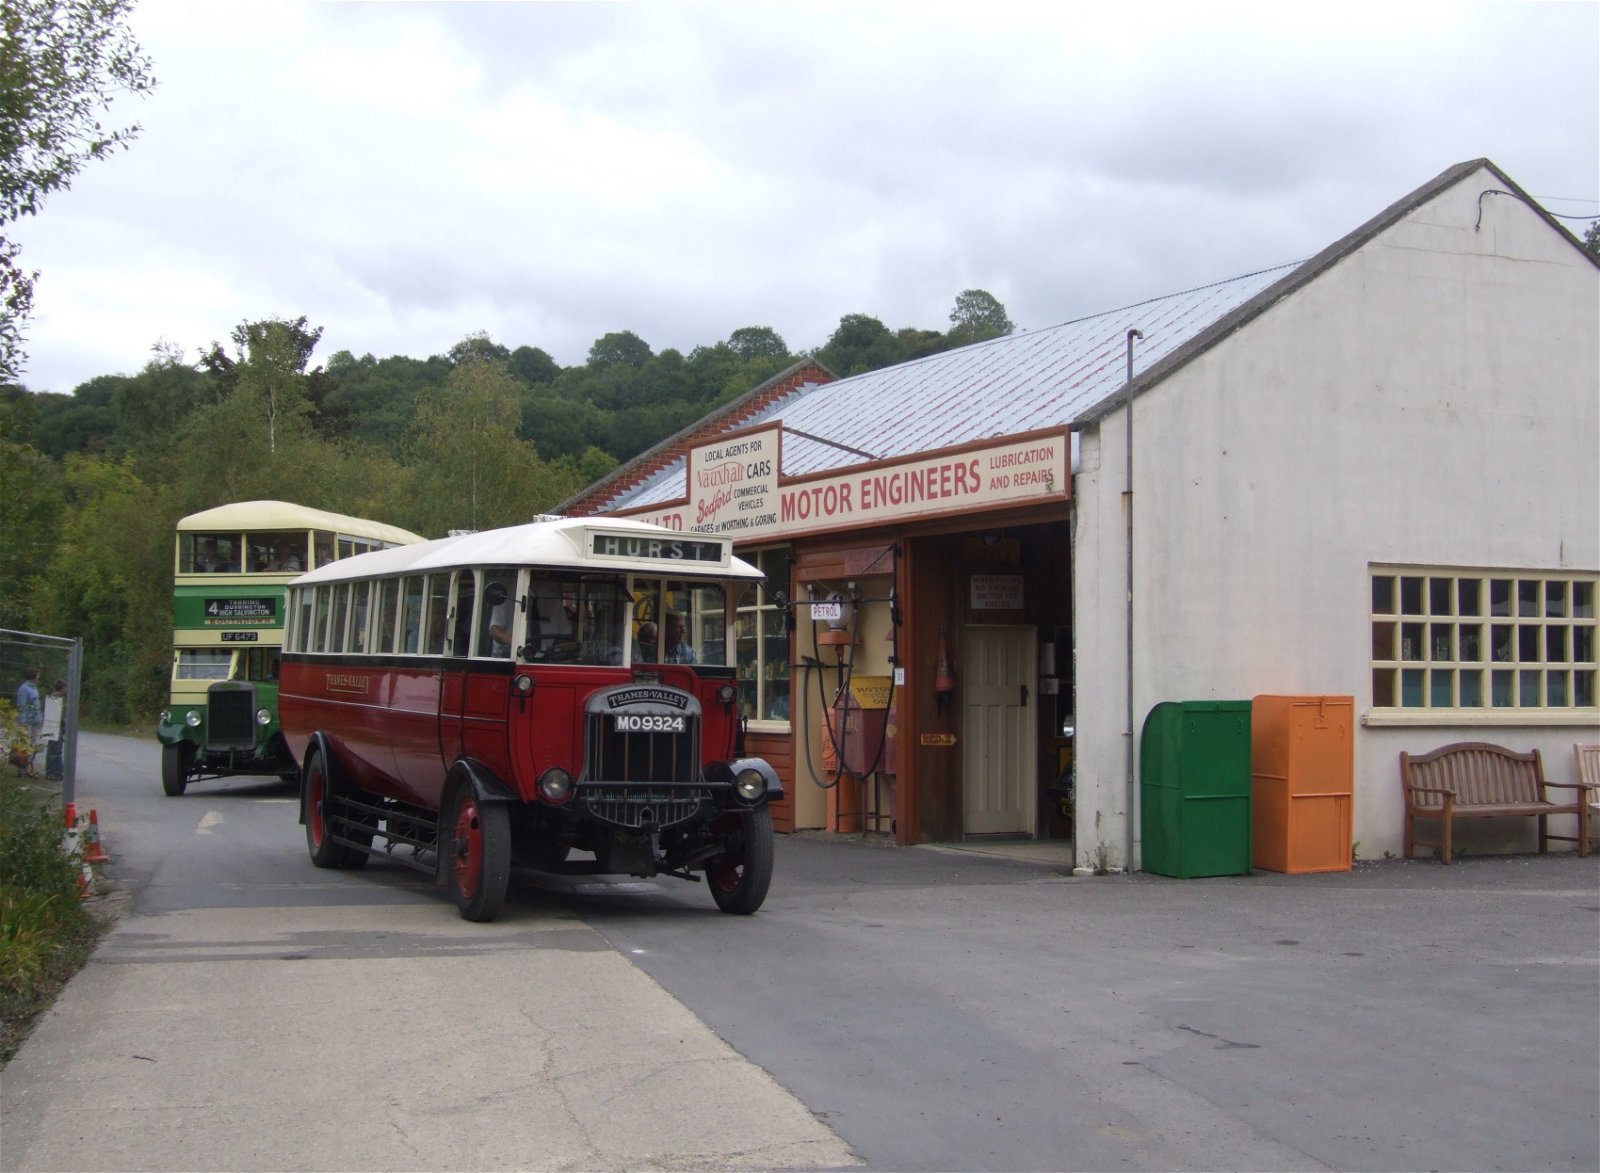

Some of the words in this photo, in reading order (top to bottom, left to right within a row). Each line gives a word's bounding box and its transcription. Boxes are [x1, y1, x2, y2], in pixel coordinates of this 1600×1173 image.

[705, 450, 723, 462] LOCAL
[725, 444, 748, 458] AGENTS
[750, 440, 762, 452] FOR
[990, 446, 1053, 469] LUBRICATION
[697, 461, 745, 488] Vauxhall
[746, 460, 771, 479] CARS
[990, 475, 1009, 491] AND
[1014, 468, 1053, 486] REPAIRS
[781, 483, 853, 522] MOTOR
[860, 459, 980, 510] ENGINEERS
[697, 484, 732, 523] Bedford
[734, 484, 768, 499] COMMERCIAL
[738, 498, 763, 511] VEHICLES
[715, 524, 721, 533] at
[721, 517, 748, 531] WORTHING
[750, 518, 754, 526] &
[755, 513, 776, 527] GORING
[605, 537, 705, 561] HURST
[208, 601, 218, 615] 4
[814, 607, 838, 616] PETROL
[223, 633, 233, 641] UF
[234, 633, 256, 641] 6473
[617, 716, 683, 731] MO9324
